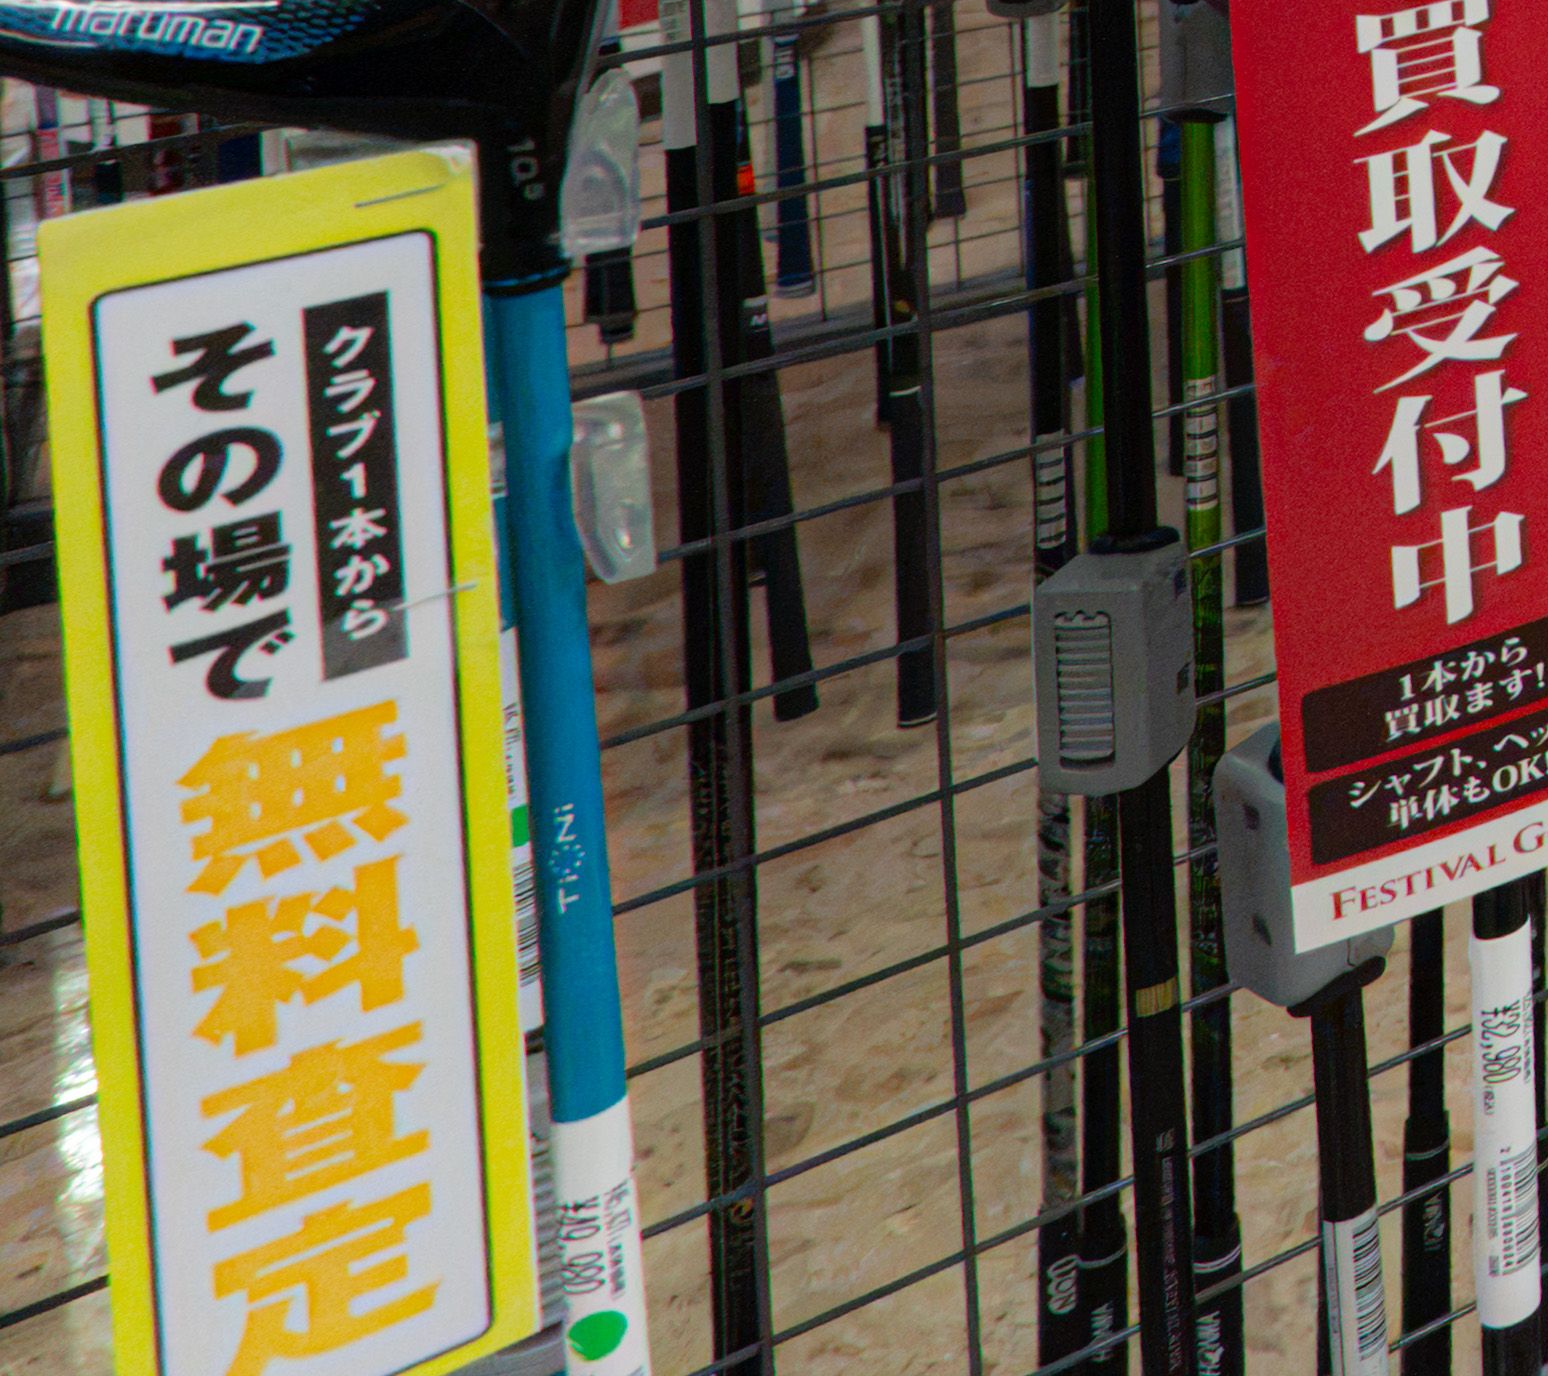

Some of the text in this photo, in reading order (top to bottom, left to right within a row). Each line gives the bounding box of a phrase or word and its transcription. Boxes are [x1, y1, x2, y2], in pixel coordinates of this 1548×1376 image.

[321, 323, 390, 640] クラブ1本から
[1330, 843, 1508, 922] FESTIVAL
